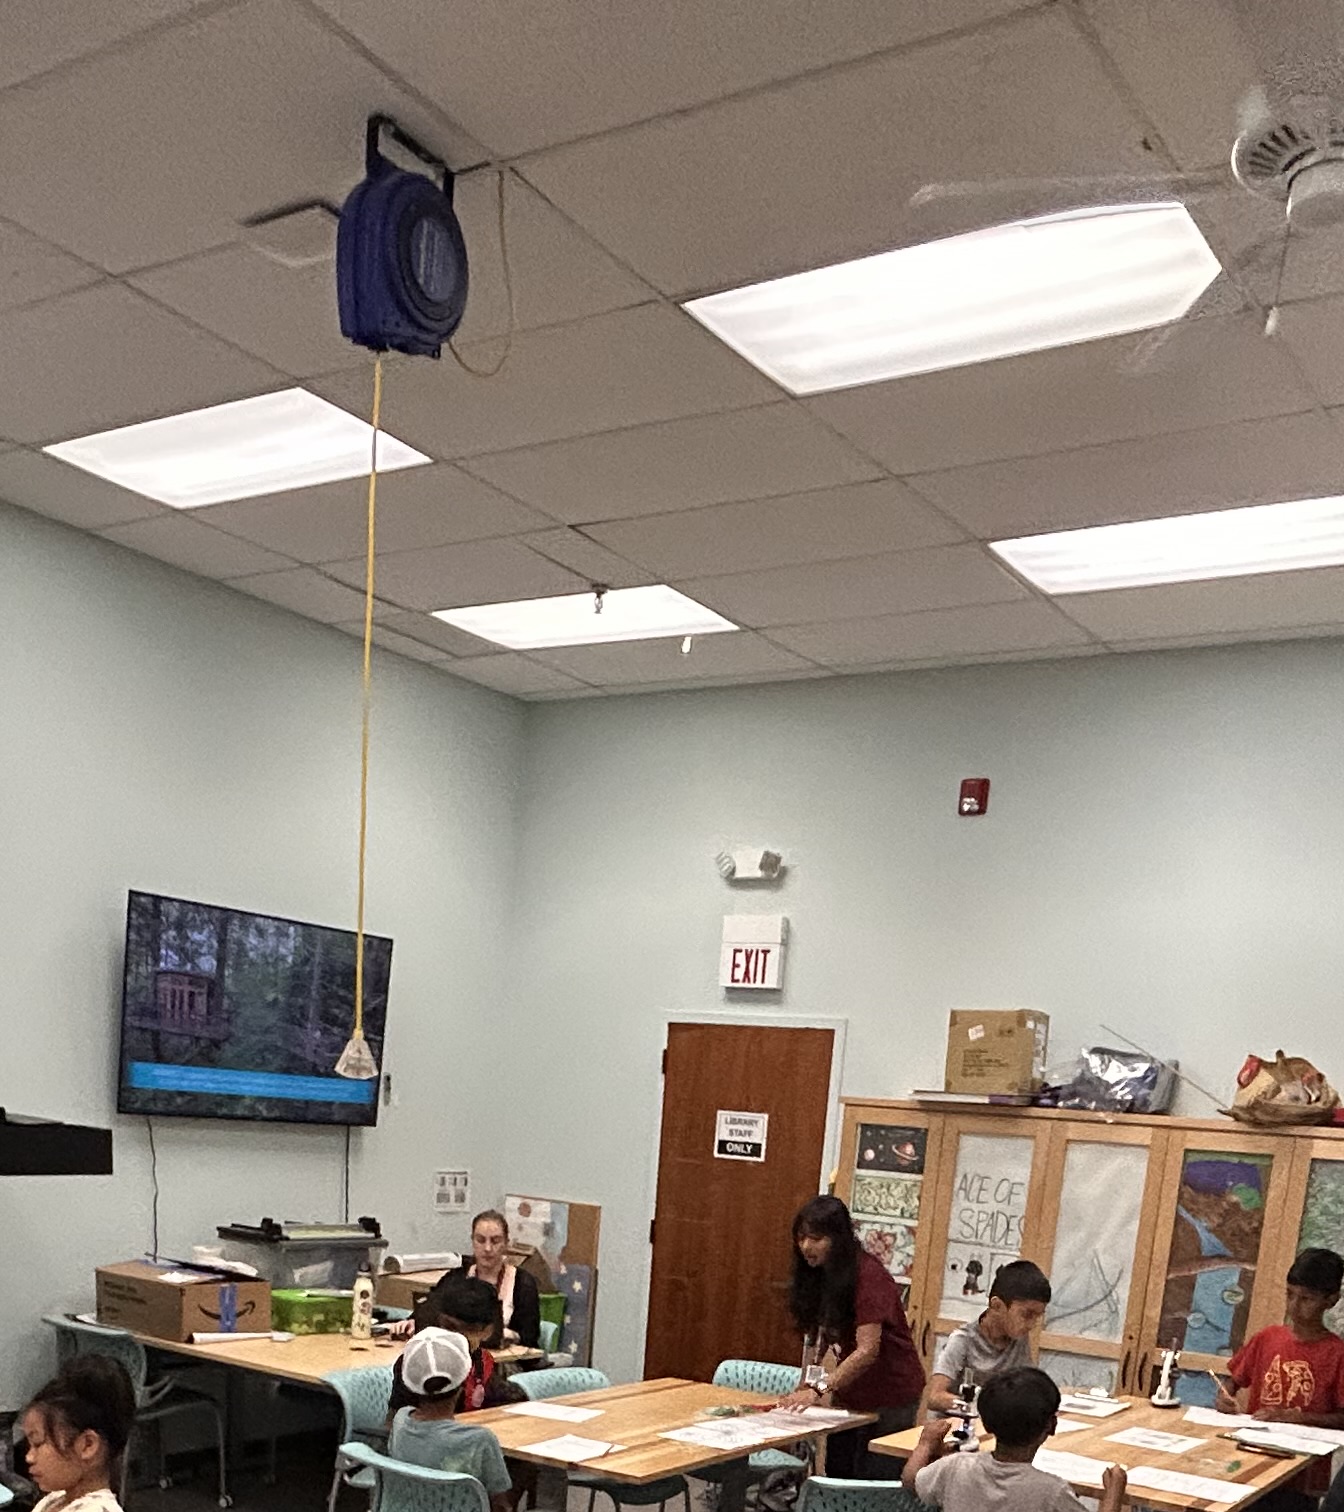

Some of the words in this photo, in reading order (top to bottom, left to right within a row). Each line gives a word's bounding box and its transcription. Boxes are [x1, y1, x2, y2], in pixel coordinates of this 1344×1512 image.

[730, 948, 771, 984] EXIT
[724, 1116, 759, 1127] LIBRARY
[728, 1129, 753, 1138] STAFF
[726, 1142, 753, 1154] ONLY
[956, 1173, 992, 1204] ACE
[994, 1178, 1025, 1206] OF
